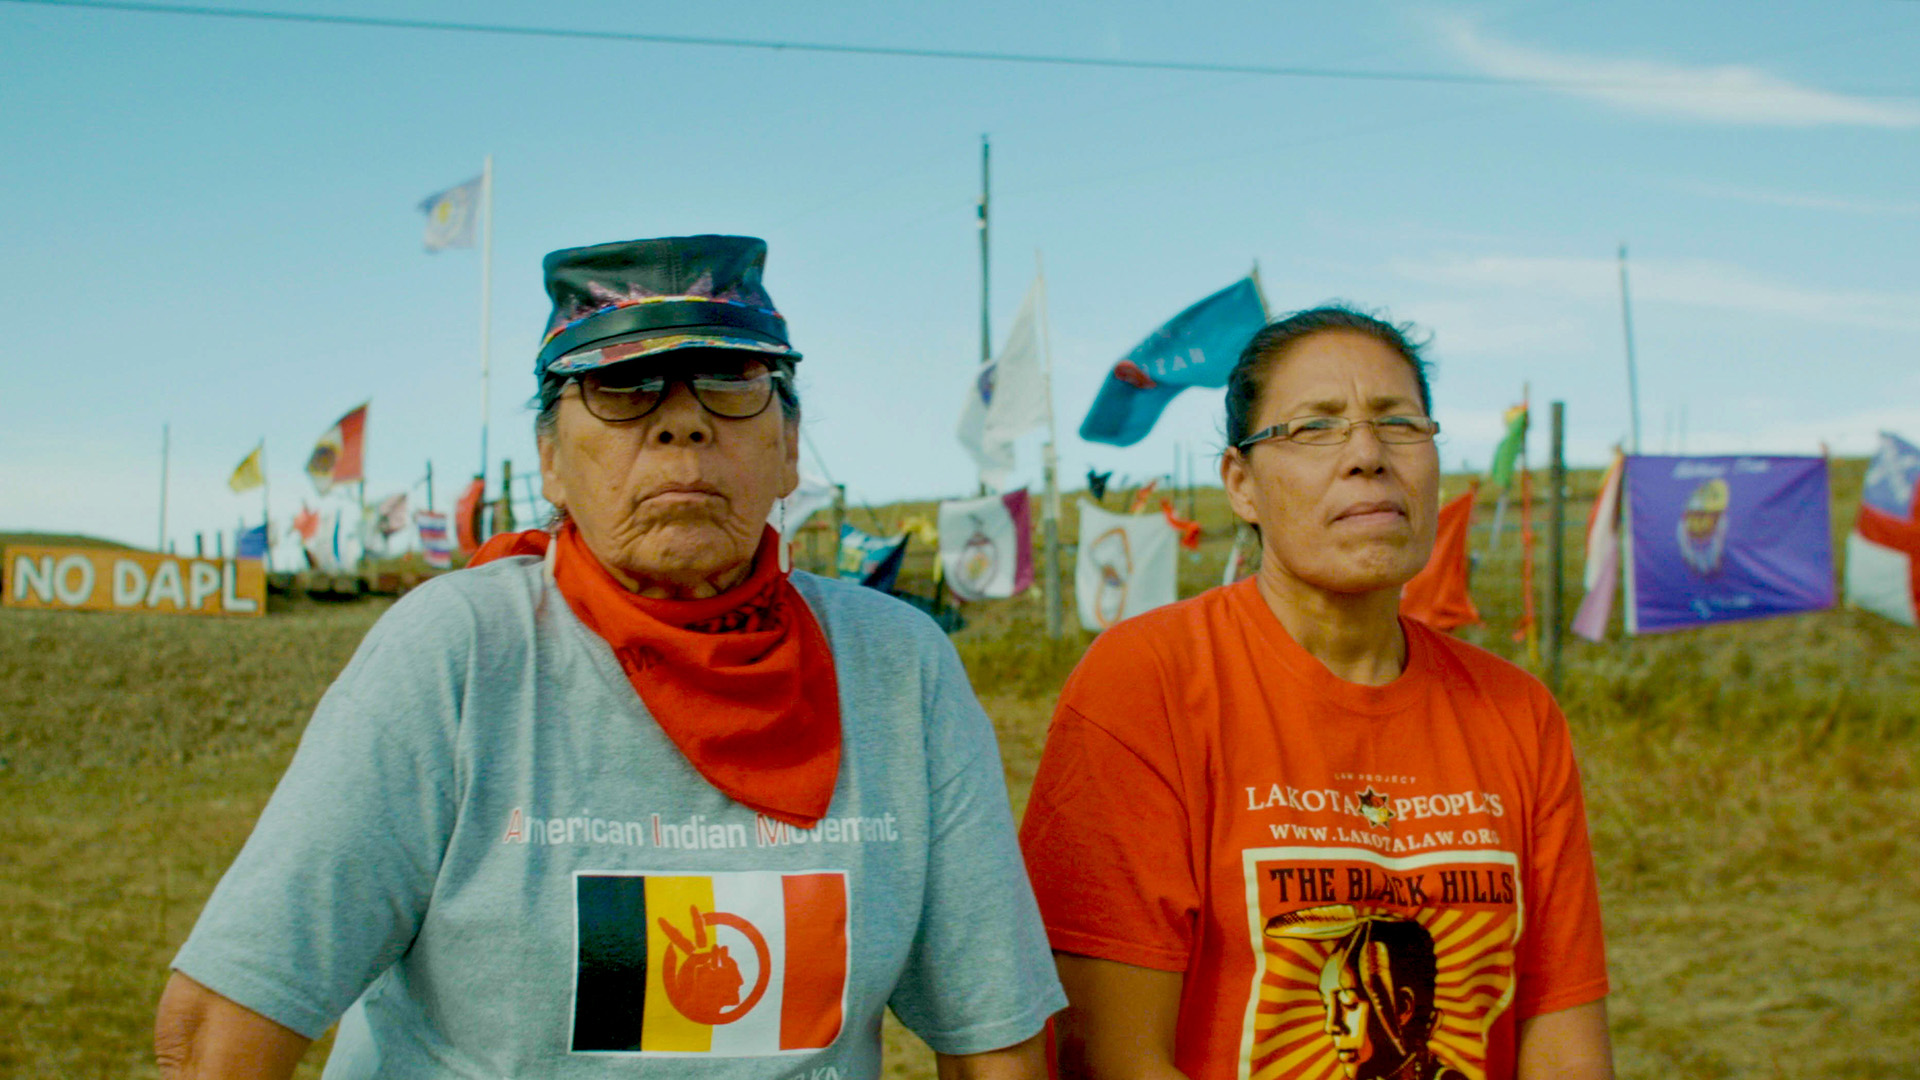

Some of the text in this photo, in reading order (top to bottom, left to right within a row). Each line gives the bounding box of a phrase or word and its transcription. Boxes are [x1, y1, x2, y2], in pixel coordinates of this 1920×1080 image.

[13, 555, 257, 613] NO DAPL
[1358, 774, 1416, 784] PROJECT
[1245, 784, 1359, 816] LAKOTA
[503, 807, 644, 846] American
[651, 813, 747, 849] Indian
[1269, 868, 1513, 906] THE BLACK HILLS
